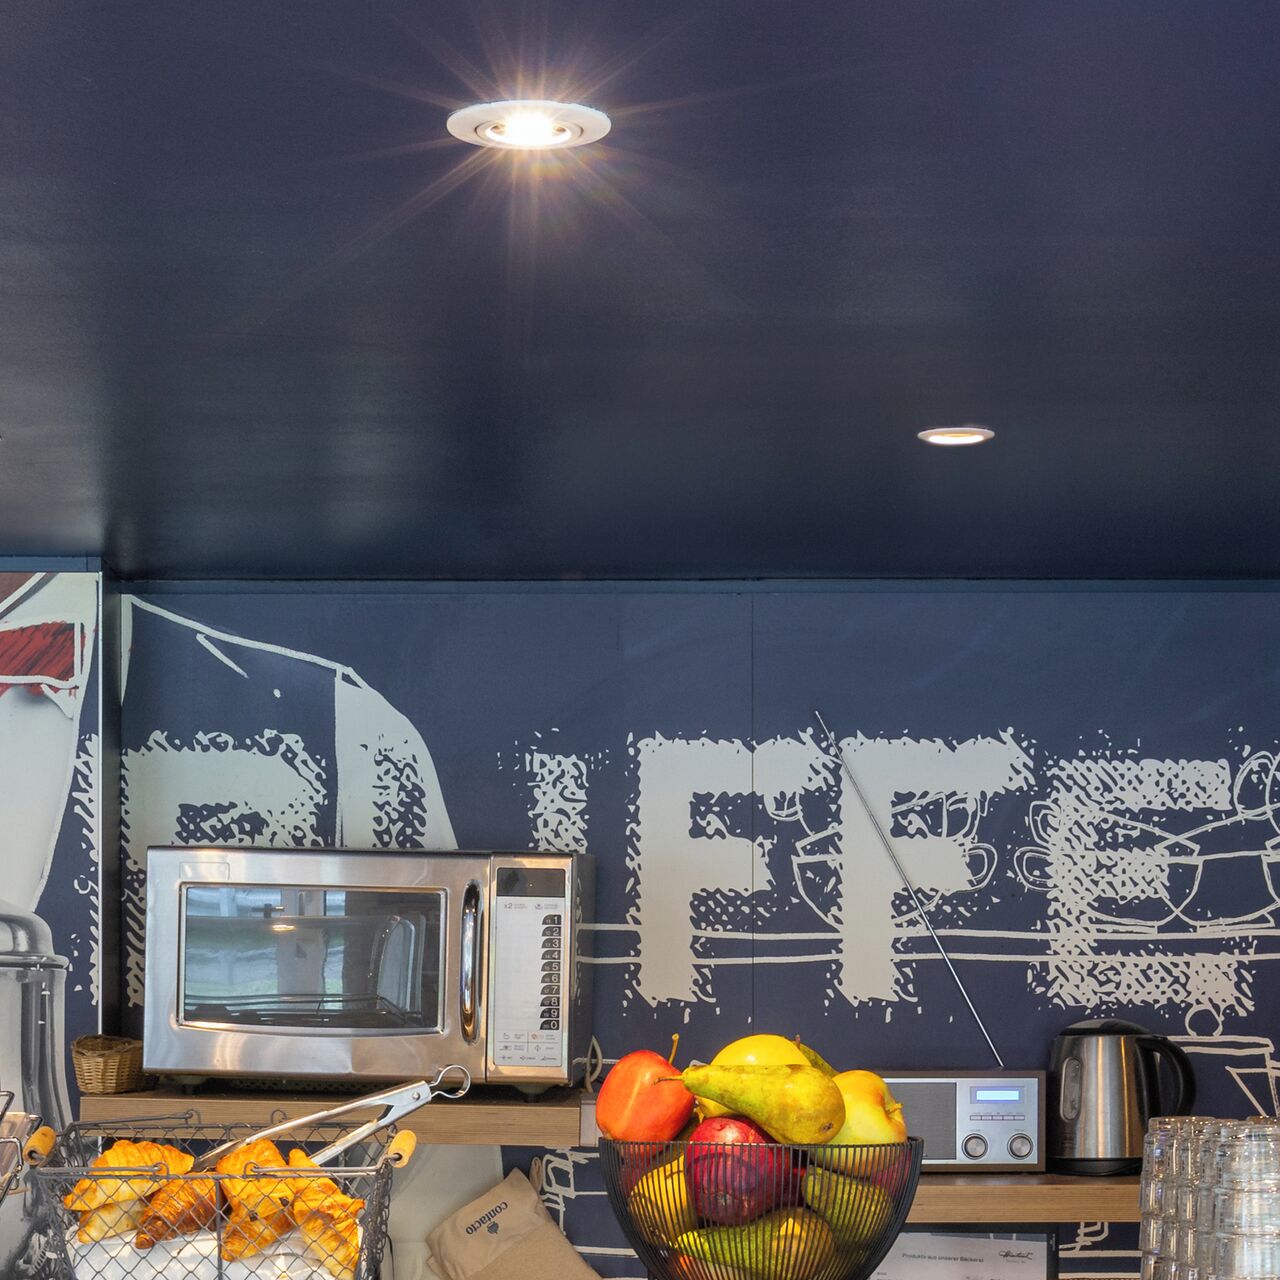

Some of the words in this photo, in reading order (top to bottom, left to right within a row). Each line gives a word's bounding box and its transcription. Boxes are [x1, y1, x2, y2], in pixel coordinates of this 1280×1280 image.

[553, 916, 558, 924] 1
[552, 928, 559, 936] 2
[552, 939, 559, 947] 3
[552, 951, 558, 959] 4
[552, 963, 558, 971] 5
[552, 986, 558, 994] 7
[551, 998, 558, 1006] 8
[551, 1009, 557, 1017] 9
[551, 1021, 557, 1029] 0
[466, 1201, 508, 1235] contacto
[902, 1252, 926, 1260] Produkte
[960, 1255, 984, 1263] Bäckerei
